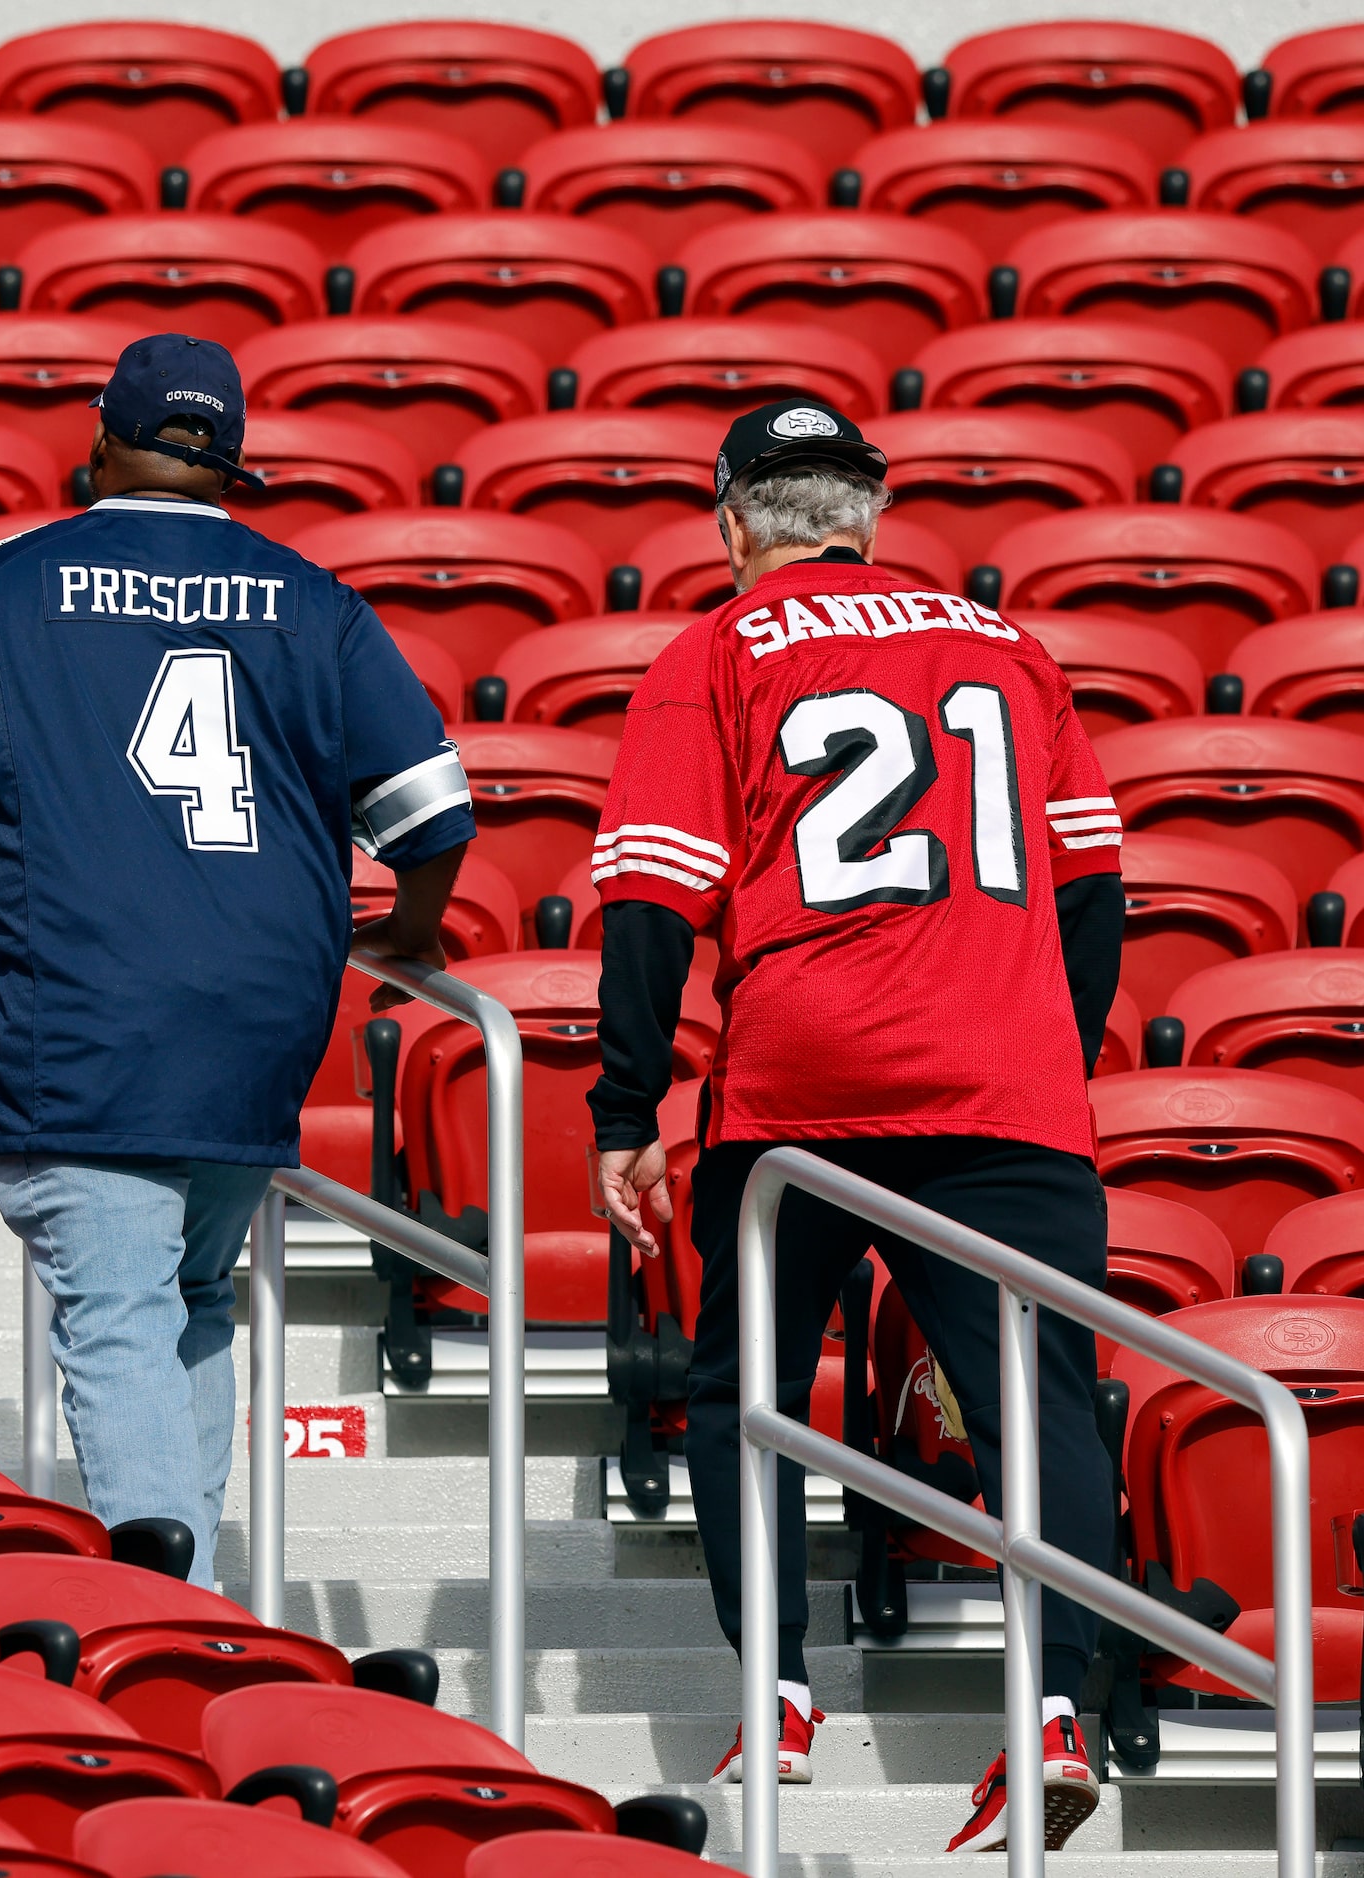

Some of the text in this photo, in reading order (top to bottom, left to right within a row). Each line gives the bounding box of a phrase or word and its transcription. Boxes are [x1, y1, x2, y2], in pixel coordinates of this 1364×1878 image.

[166, 390, 225, 413] COWBOYS
[59, 566, 284, 624] PRESCOTT
[736, 590, 1020, 659] SANDERS
[126, 648, 259, 853] 4
[777, 681, 1028, 914] 21
